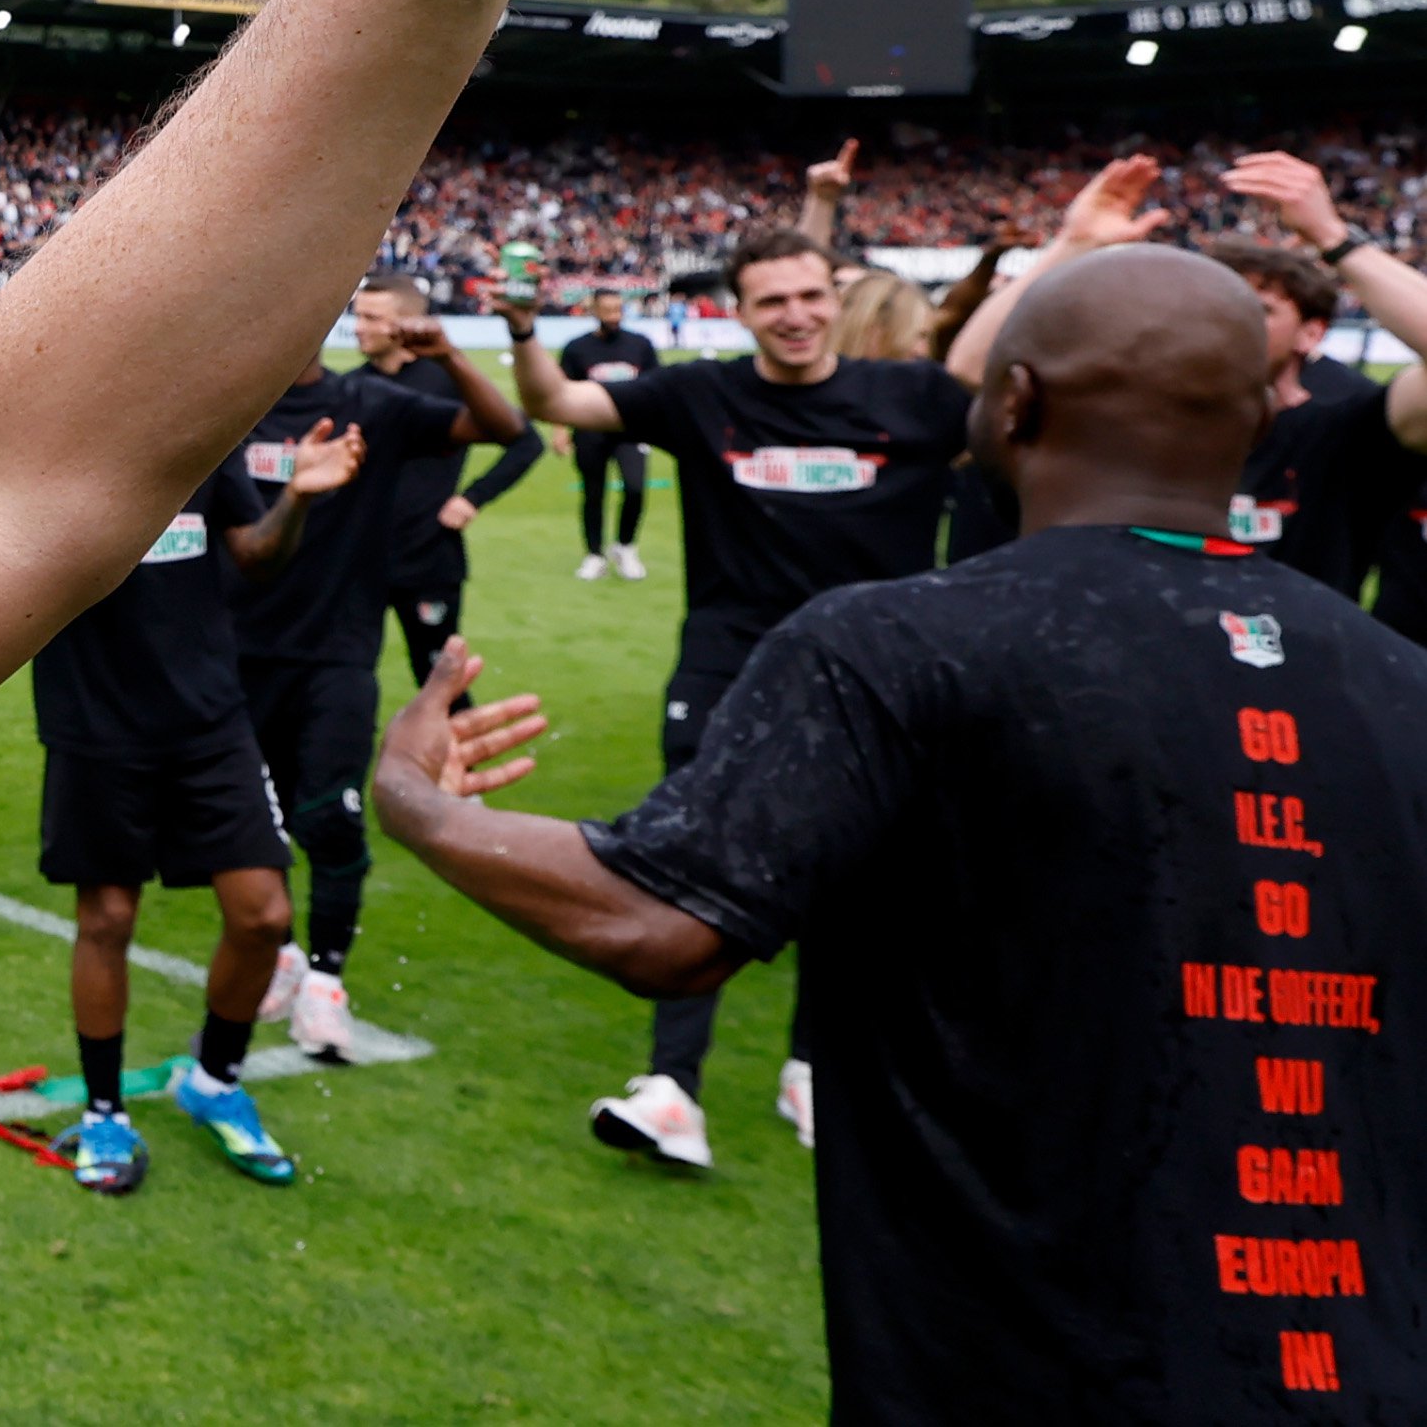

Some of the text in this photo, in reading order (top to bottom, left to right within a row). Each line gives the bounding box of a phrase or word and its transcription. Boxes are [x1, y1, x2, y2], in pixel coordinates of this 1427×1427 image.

[1237, 706, 1300, 764] GO
[1253, 878, 1311, 938] GO
[1181, 962, 1217, 1019] IN
[1221, 964, 1266, 1023] DE
[1236, 1144, 1343, 1206] GAAN
[1213, 1233, 1365, 1298] EUROPA
